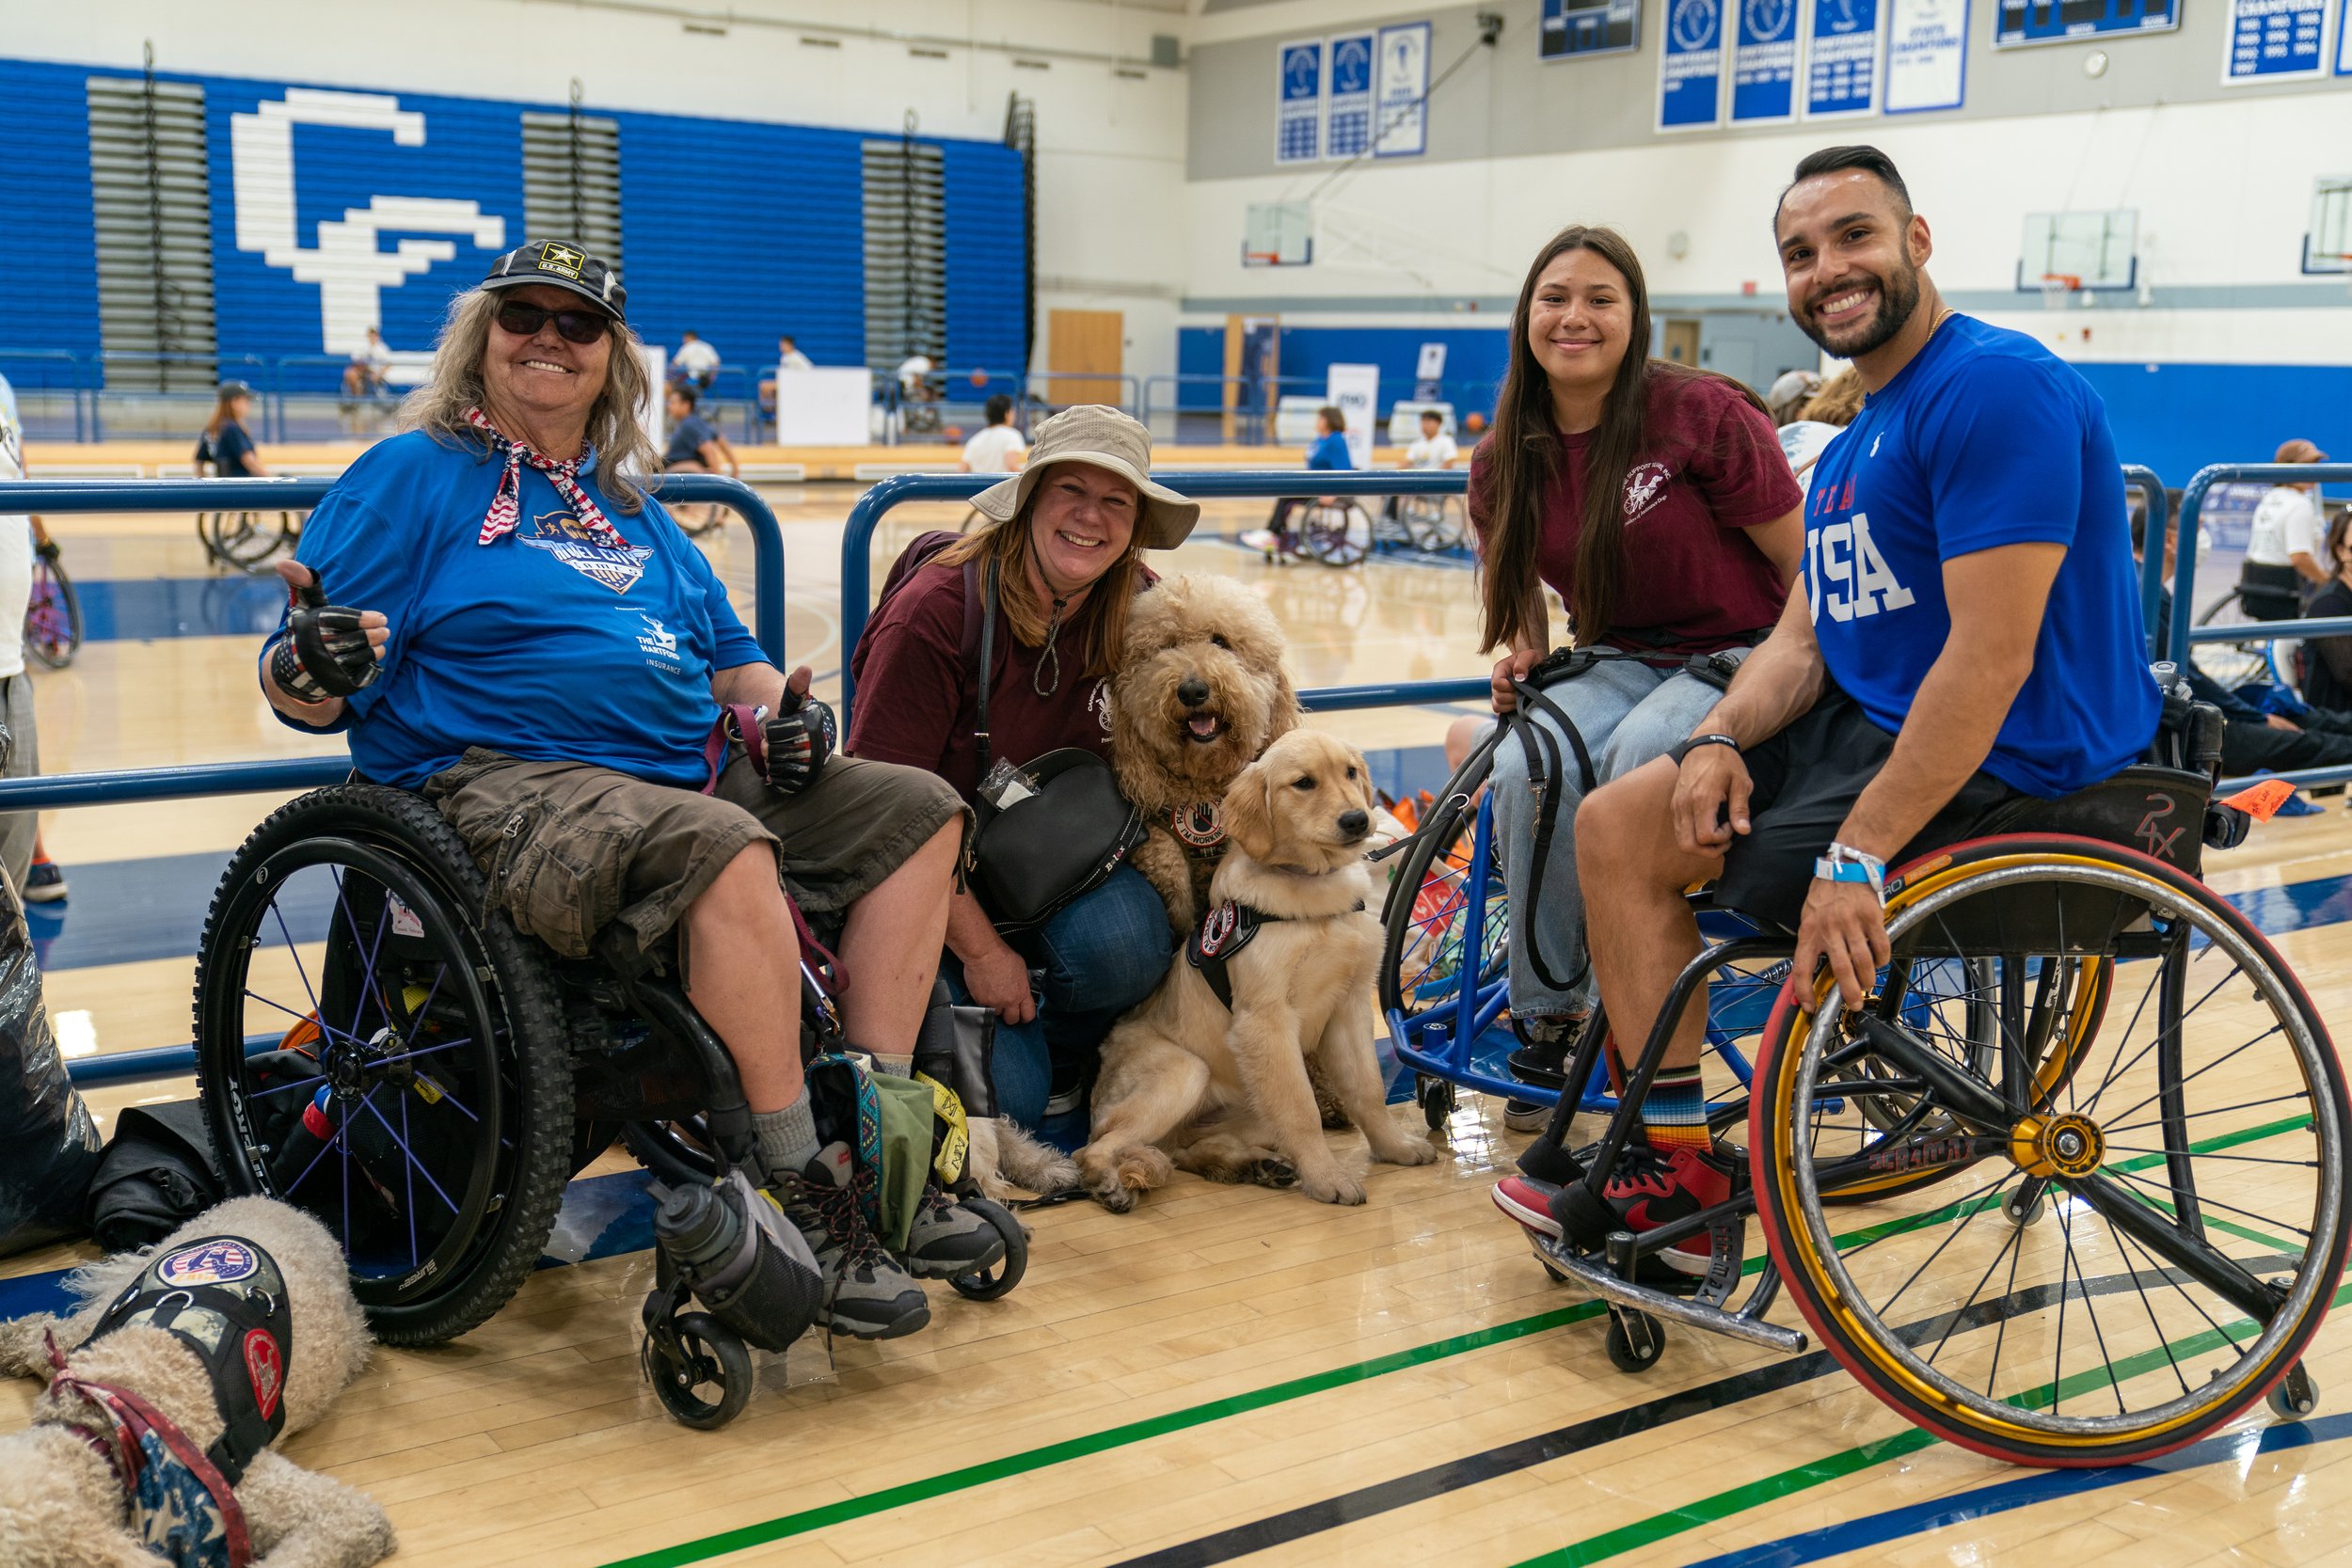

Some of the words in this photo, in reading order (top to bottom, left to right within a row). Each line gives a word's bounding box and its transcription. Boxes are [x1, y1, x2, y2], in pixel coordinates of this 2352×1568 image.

[556, 266, 576, 277] ARMY
[1627, 463, 1652, 479] SUPPORT
[552, 541, 602, 562] ANGEL
[596, 547, 642, 568] CITY
[636, 636, 655, 646] THE
[641, 644, 680, 660] HARTFORD
[645, 658, 681, 675] INSURANCE
[1176, 804, 1186, 824] PLEA
[1181, 829, 1192, 839] I'M
[405, 1259, 437, 1288] SURGE
